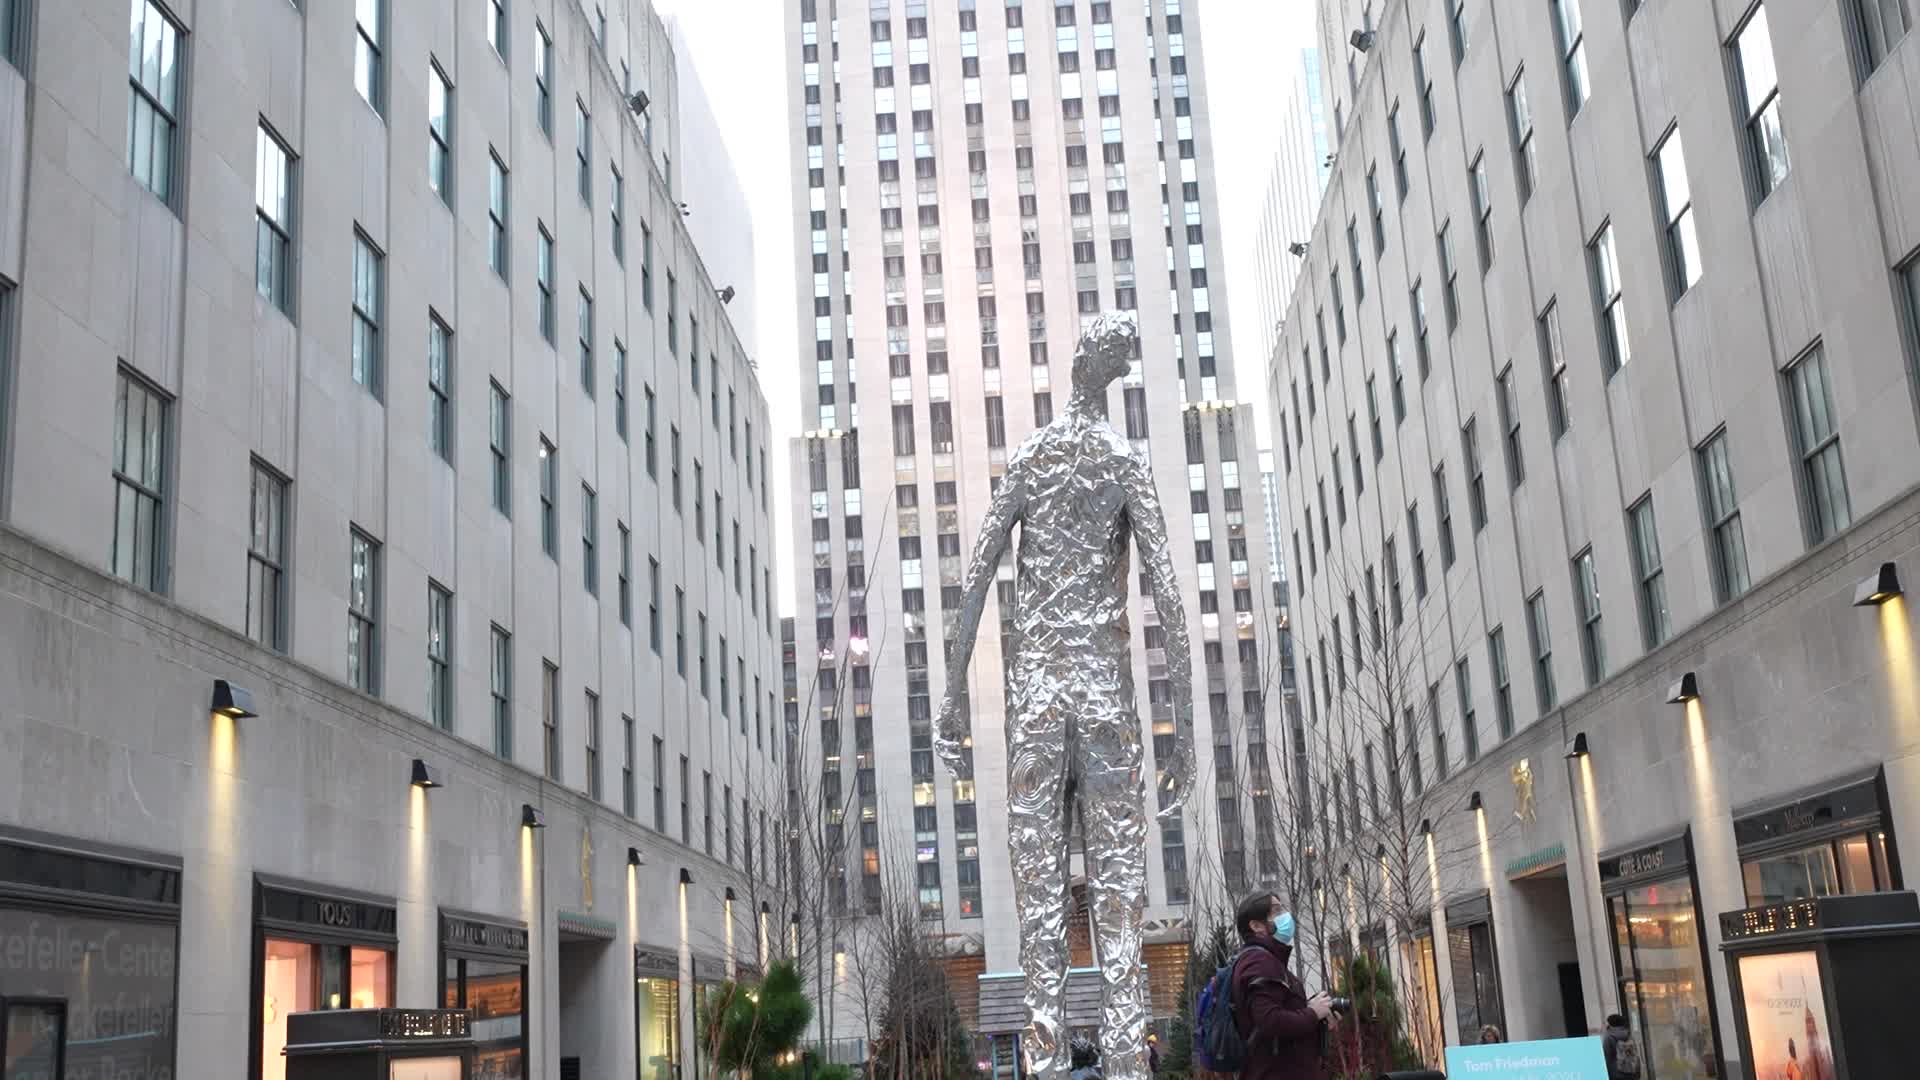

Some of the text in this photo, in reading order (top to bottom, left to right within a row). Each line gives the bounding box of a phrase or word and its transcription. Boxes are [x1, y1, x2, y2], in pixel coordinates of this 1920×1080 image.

[320, 902, 352, 926] TOUS
[1464, 1055, 1560, 1072] Tom Friedman
